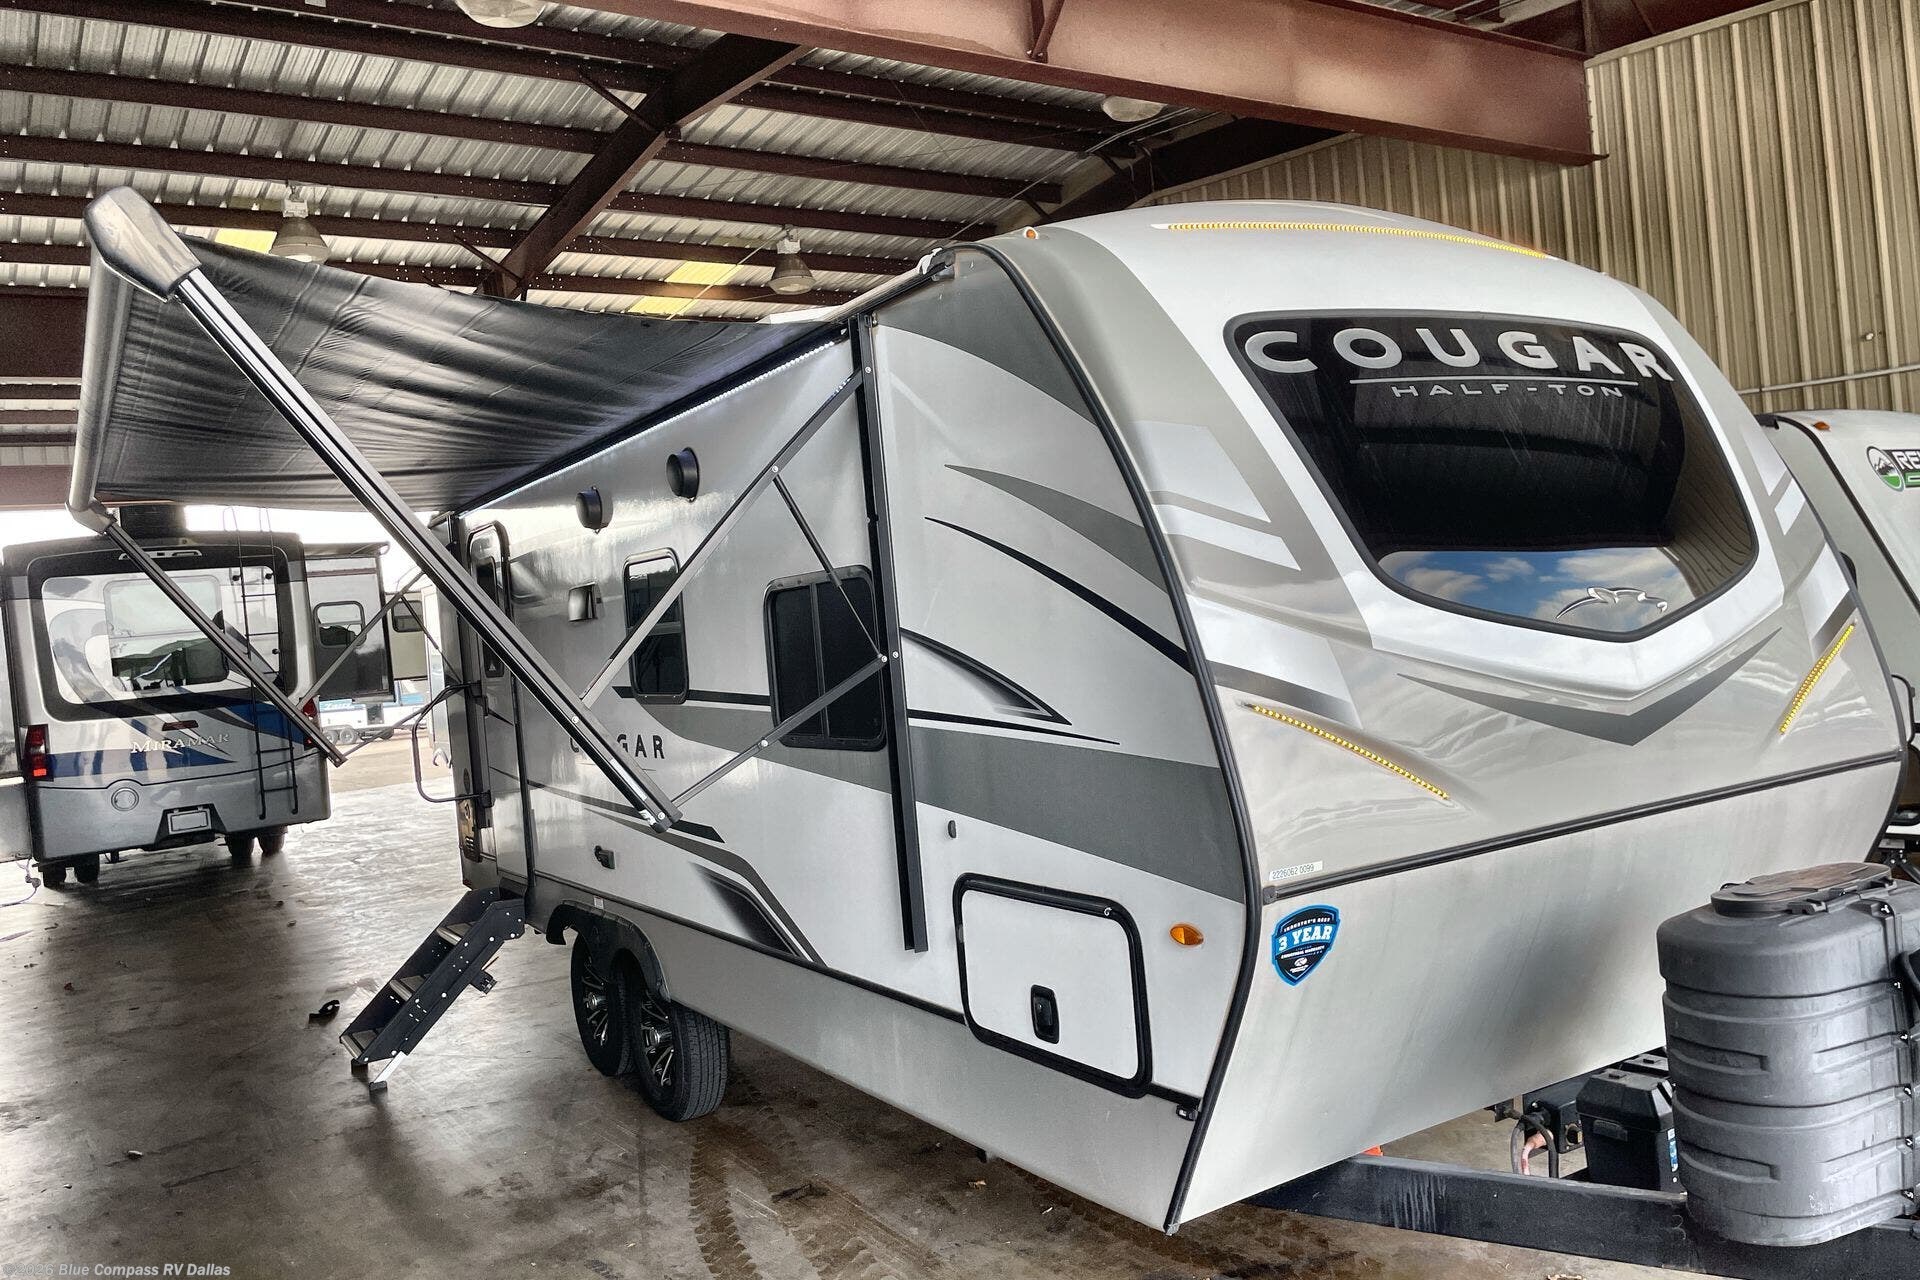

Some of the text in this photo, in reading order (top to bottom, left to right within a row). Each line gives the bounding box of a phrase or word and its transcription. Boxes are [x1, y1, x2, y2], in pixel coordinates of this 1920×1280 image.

[1244, 328, 1674, 381] COUGAR
[1391, 383, 1623, 398] HALF-TON
[130, 733, 229, 754] MIRAMAR
[1278, 925, 1333, 951] 3 YEAR
